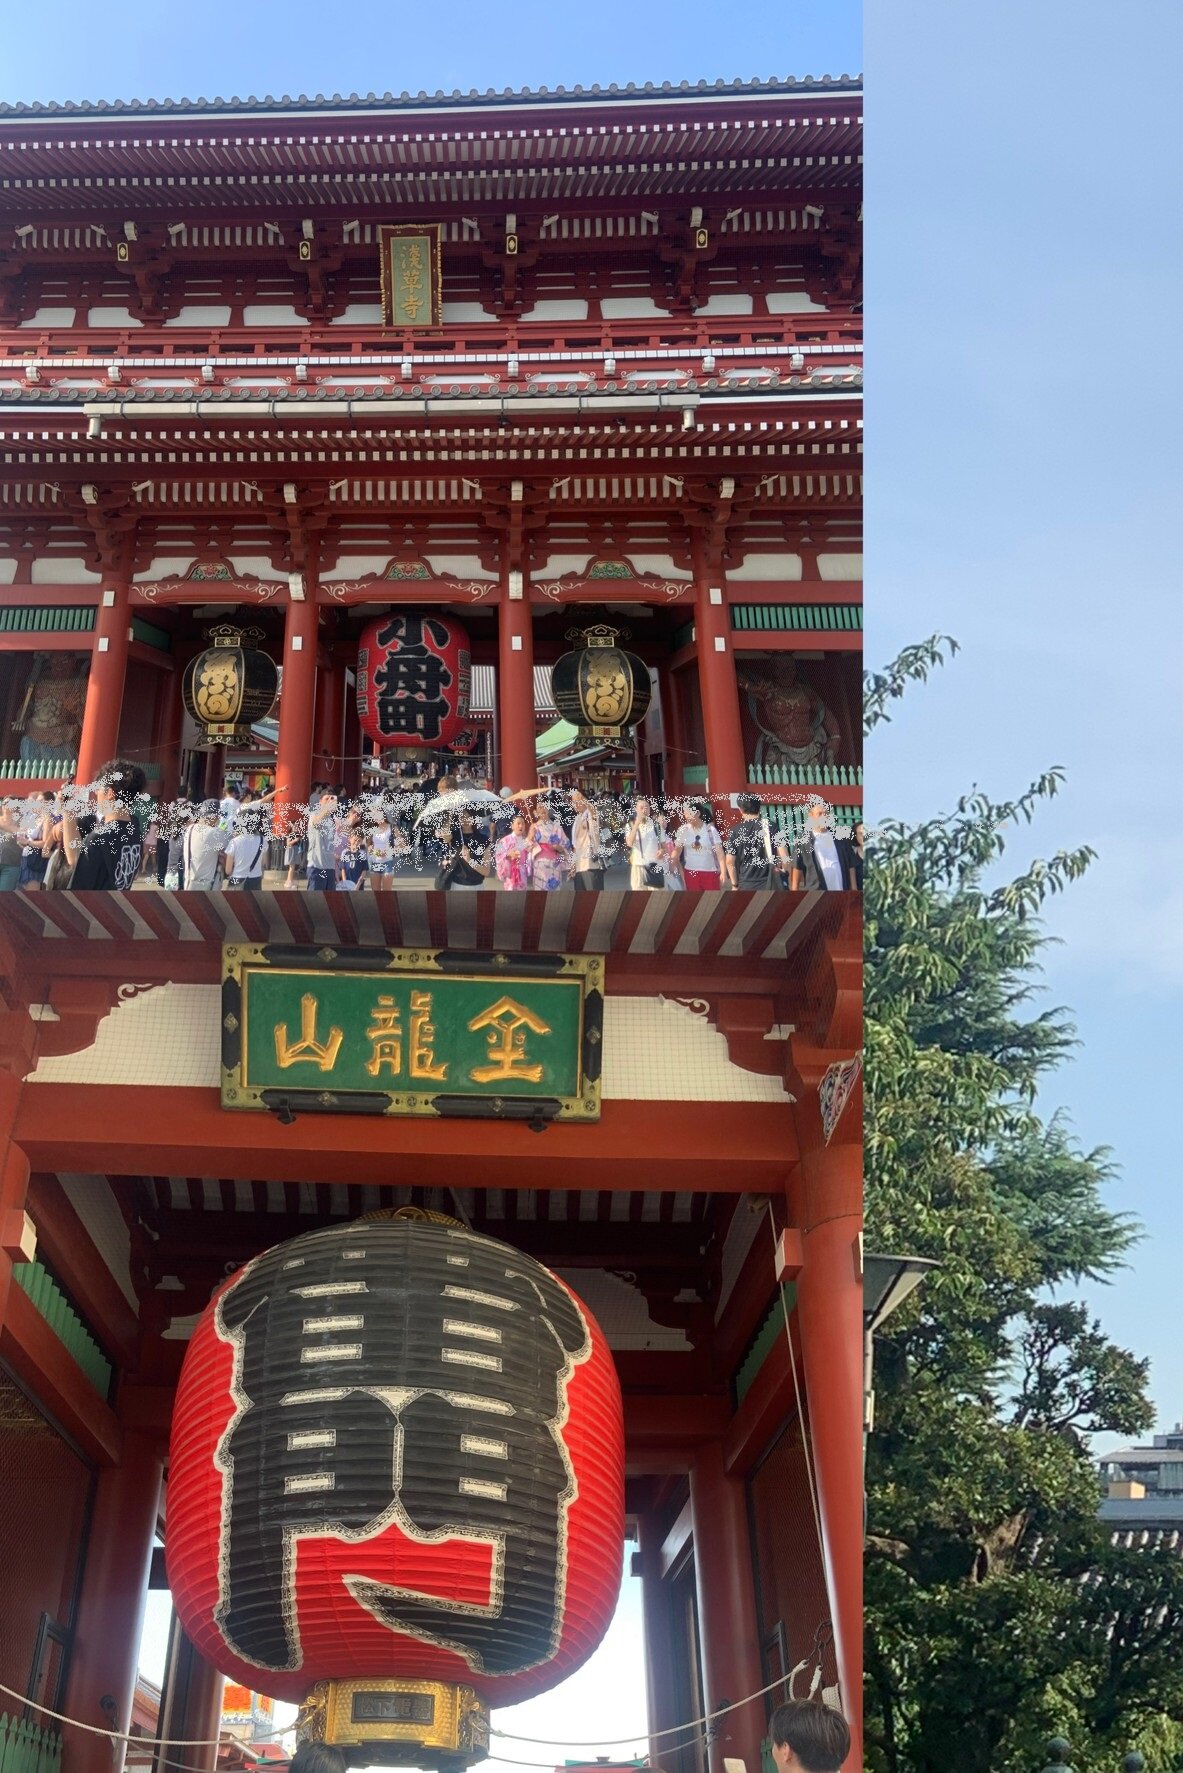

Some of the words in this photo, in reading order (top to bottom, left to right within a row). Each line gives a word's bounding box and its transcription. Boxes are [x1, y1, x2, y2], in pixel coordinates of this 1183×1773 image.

[374, 612, 453, 742] 小舟町
[213, 1222, 593, 1678] 雷門
